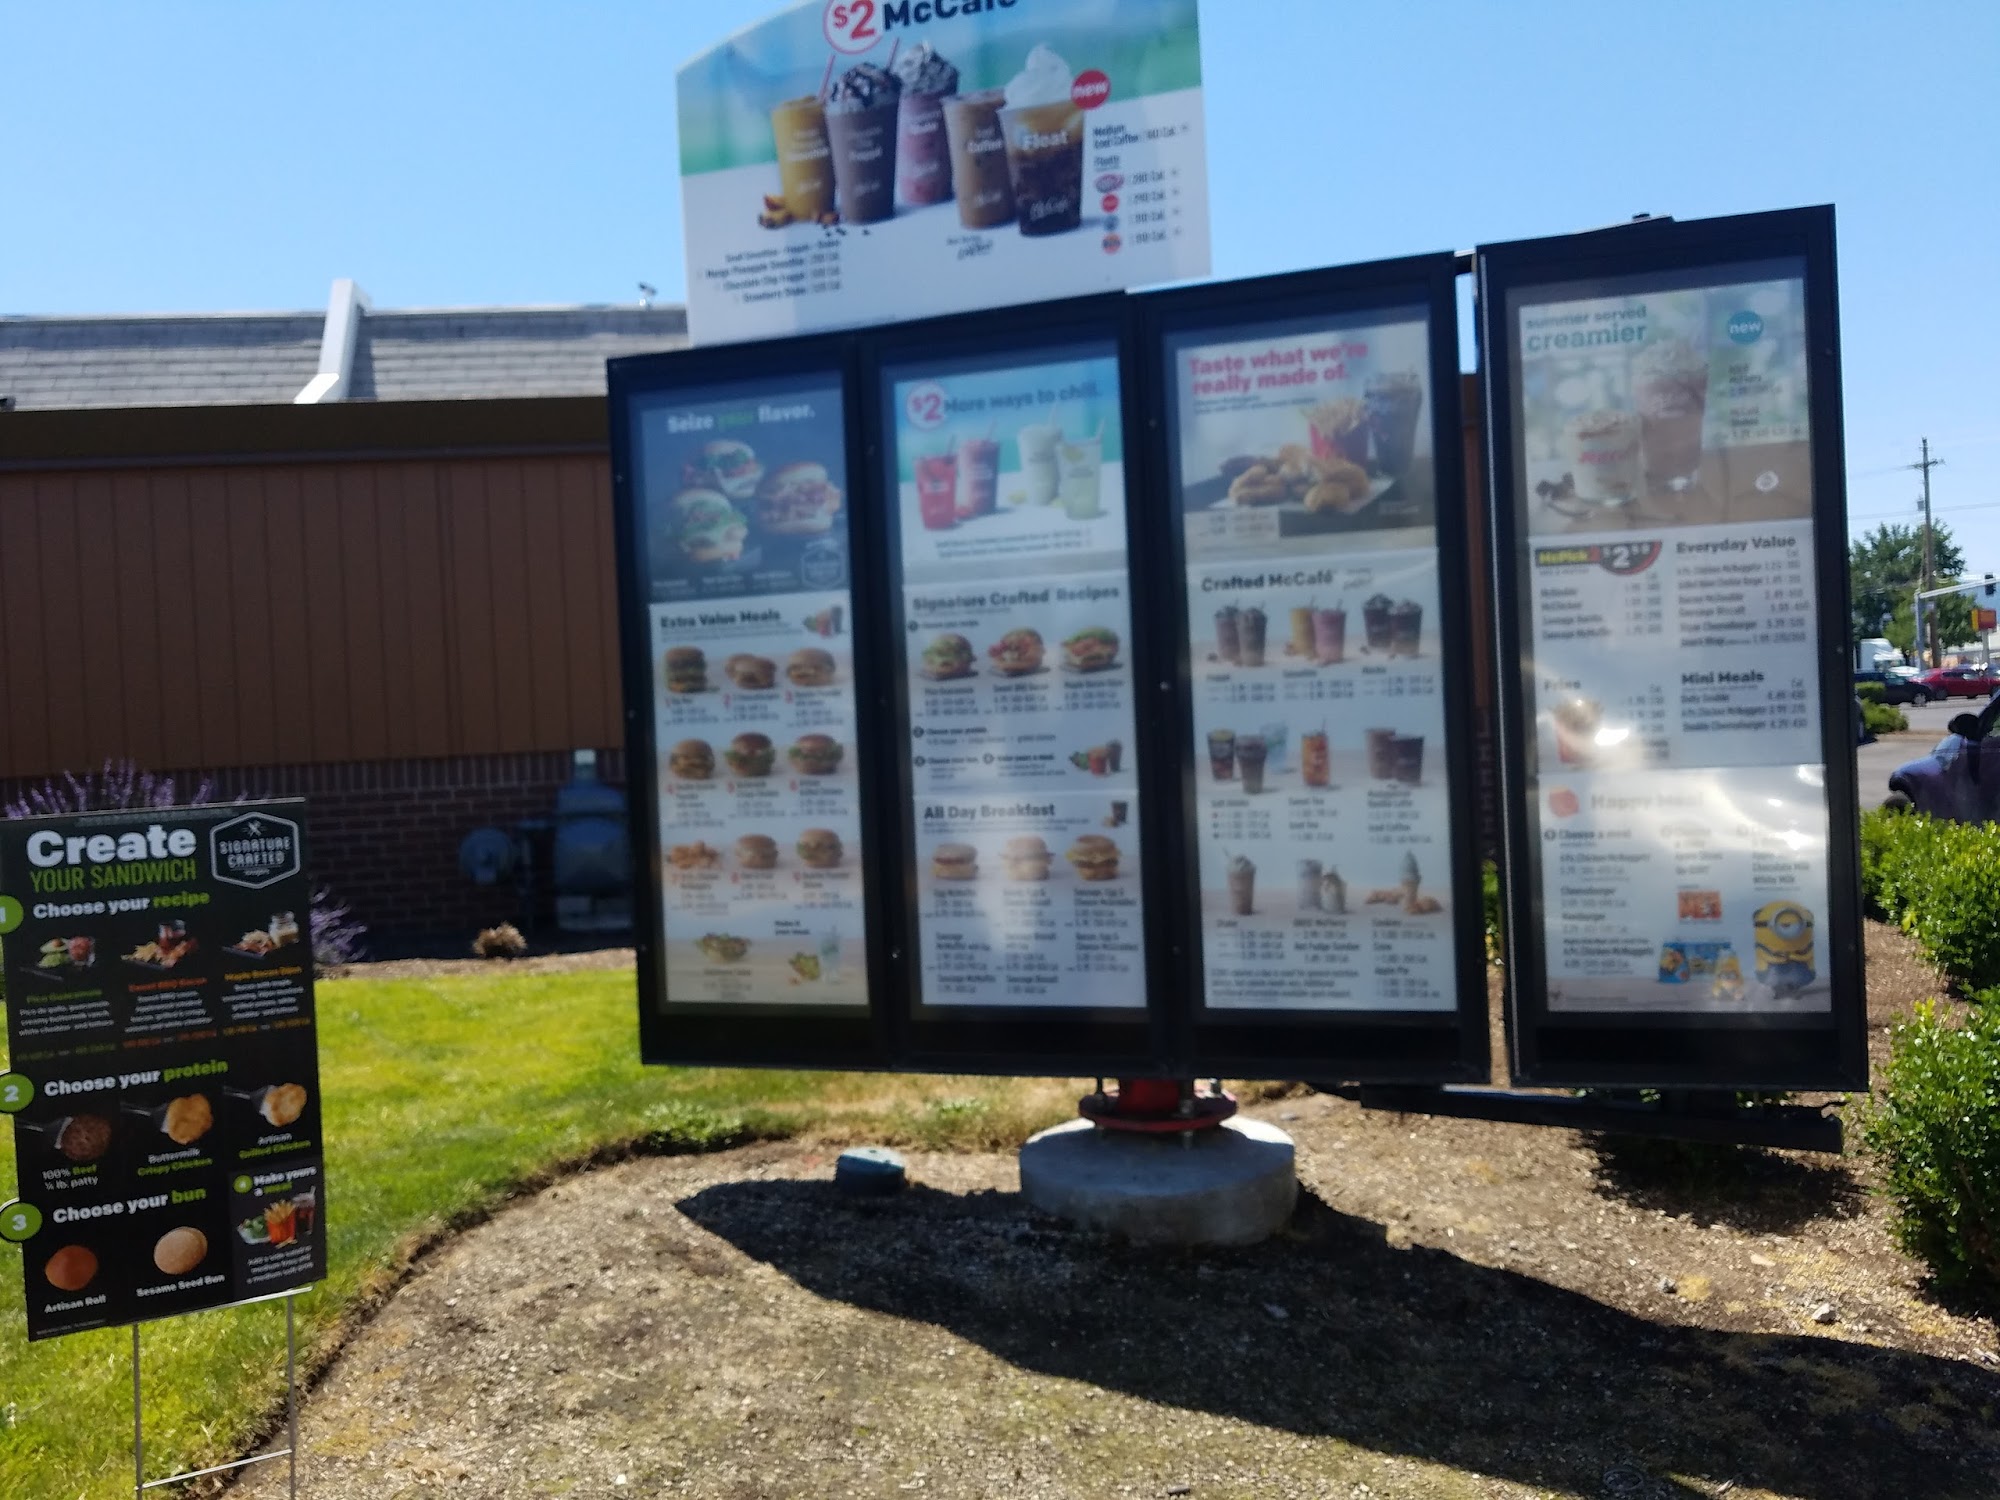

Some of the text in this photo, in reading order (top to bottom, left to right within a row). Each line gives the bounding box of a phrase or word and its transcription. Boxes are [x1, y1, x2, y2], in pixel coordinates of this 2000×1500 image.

[833, 0, 877, 40] $2
[1072, 79, 1106, 99] new
[1526, 322, 1648, 350] creamier
[1728, 319, 1761, 335] new
[1190, 357, 1245, 376] Taste
[1250, 349, 1304, 369] what
[1192, 374, 1251, 396] really
[1258, 368, 1318, 389] made
[945, 396, 986, 414] More
[990, 391, 1033, 409] ways
[1038, 388, 1056, 403] to
[1676, 535, 1797, 555] Everyday Value
[1202, 570, 1333, 592] Crafted McCafé
[913, 586, 1120, 612] Signature Crafted Recipes
[661, 609, 781, 629] Extra Value Meals
[1681, 670, 1764, 685] Mini Meals
[924, 803, 1056, 821] All Day Breakfast
[26, 824, 197, 868] Create
[219, 836, 291, 855] SIGNATURE
[227, 851, 286, 866] CRAFTED
[30, 859, 198, 893] YOUR SANDWICH
[33, 891, 211, 920] Choose your recipe
[44, 1060, 229, 1097] Choose your protein
[5, 1085, 19, 1102] 2
[257, 1132, 293, 1146] Artisan
[70, 1175, 99, 1190] patty
[253, 1166, 318, 1187] Make yours
[53, 1187, 208, 1224] Choose your bun
[12, 1213, 27, 1231] 3
[136, 1273, 226, 1298] Sesame Seed Bun
[44, 1298, 85, 1314] Artisan
